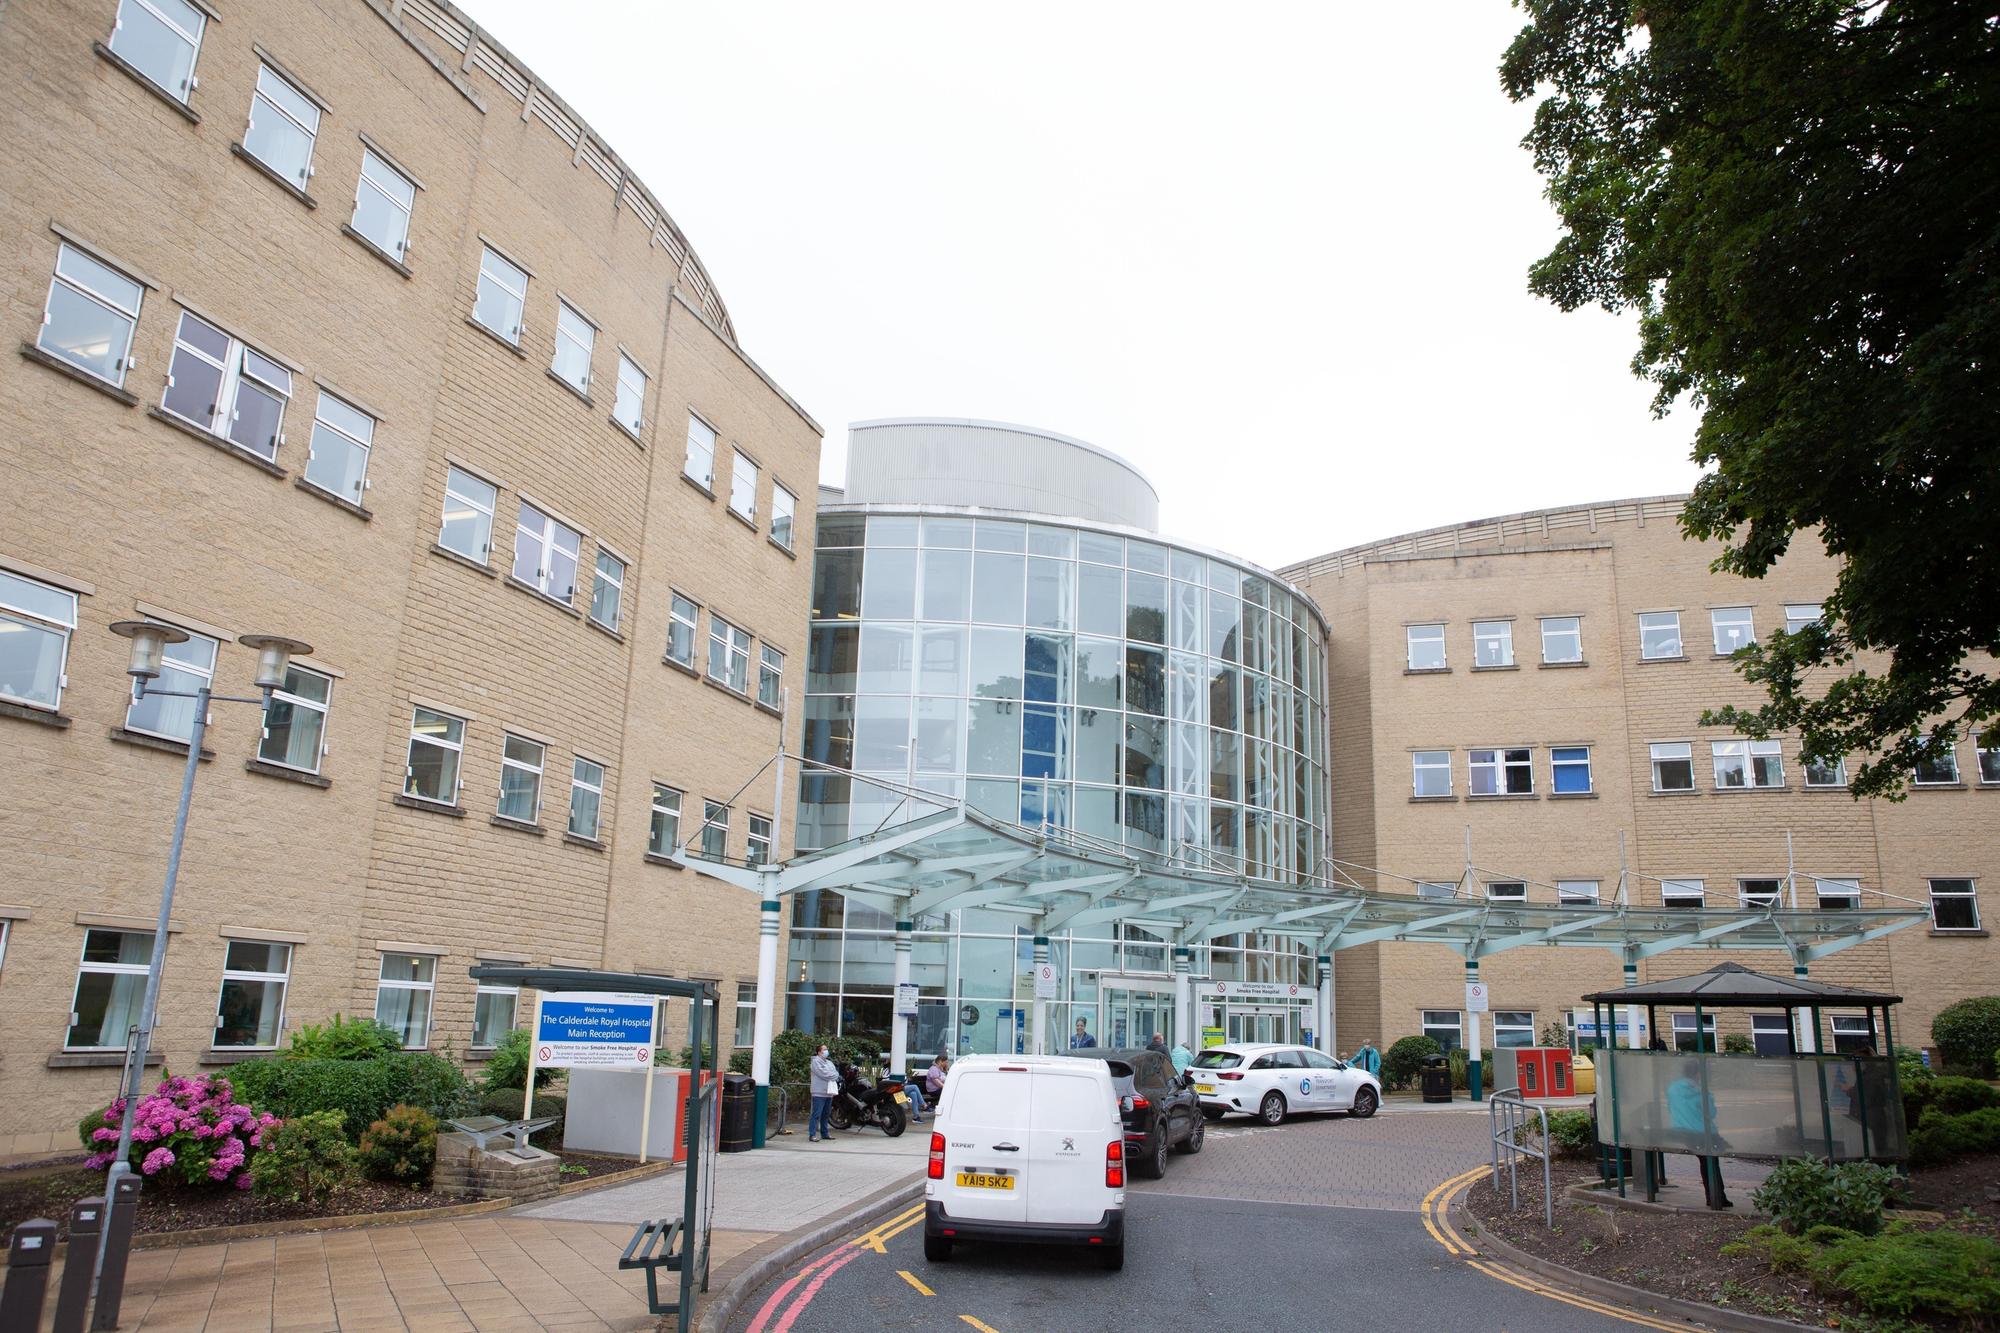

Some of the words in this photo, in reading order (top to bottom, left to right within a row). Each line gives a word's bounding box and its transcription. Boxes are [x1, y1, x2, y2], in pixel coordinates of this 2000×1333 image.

[543, 1015, 557, 1024] The
[558, 1016, 599, 1025] Calderdale
[600, 1017, 621, 1028] Royal
[622, 1018, 651, 1028] Hospital
[568, 1029, 587, 1038] Main
[589, 1029, 626, 1040] Reception
[963, 1174, 986, 1186] YA19
[988, 1177, 1008, 1188] SKZ
